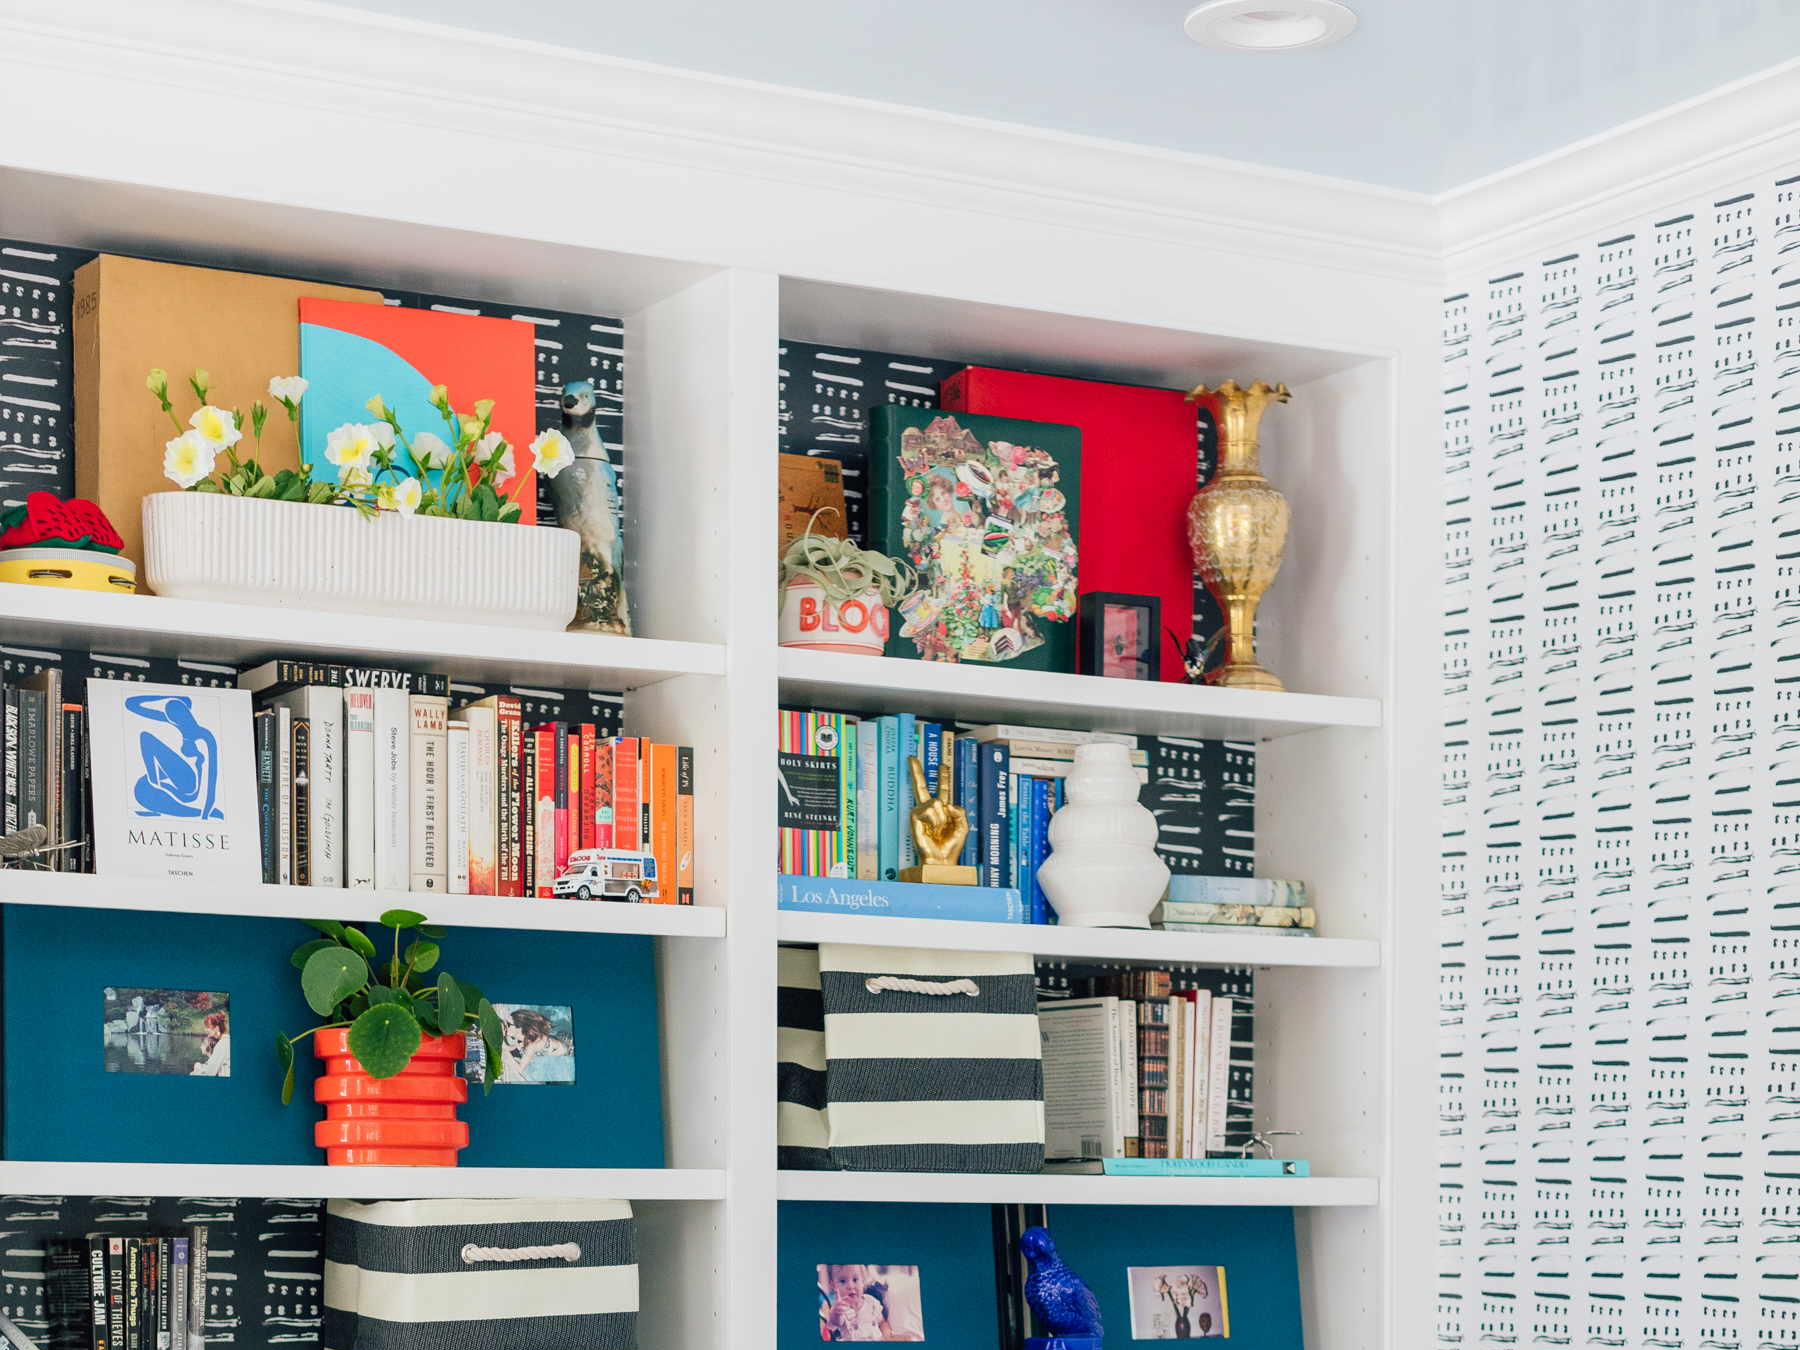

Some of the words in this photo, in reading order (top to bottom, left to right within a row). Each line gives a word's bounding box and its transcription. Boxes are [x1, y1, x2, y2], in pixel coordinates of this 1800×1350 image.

[75, 292, 97, 320] 1985
[344, 669, 411, 690] SWERVE
[350, 693, 372, 709] BELOVED
[415, 708, 445, 718] WALLY
[6, 705, 17, 727] BLACK
[417, 720, 443, 730] LAMB
[323, 721, 334, 749] DONNA
[500, 735, 508, 758] Osage
[511, 720, 519, 767] Killers
[390, 751, 398, 770] Jobs
[426, 742, 434, 757] THE
[527, 756, 532, 764] WE
[864, 742, 873, 760] The
[928, 741, 938, 765] HOUSE
[6, 751, 17, 776] WHITE
[324, 753, 332, 783] TARTT
[426, 762, 434, 785] HOUR
[511, 769, 519, 778] of
[780, 759, 801, 767] HOLY
[805, 761, 836, 769] SKIRTS
[28, 766, 36, 801] PAPERS
[390, 772, 398, 782] by
[864, 762, 874, 791] Island
[929, 782, 938, 794] THE
[282, 795, 288, 806] OF
[887, 766, 895, 812] BUDDHA
[1021, 782, 1029, 809] Setting
[426, 796, 434, 821] FIRST
[511, 792, 519, 840] Flower
[998, 791, 1006, 818] James
[128, 829, 230, 850] MATISSE
[426, 826, 434, 867] BELIEVED
[501, 843, 508, 853] of
[846, 825, 854, 872] VONNEGUT
[990, 823, 999, 865] MORNING
[791, 885, 822, 904] Los
[825, 887, 889, 910] Angeles
[92, 1250, 104, 1296] CULTURE
[129, 1247, 137, 1279] Among
[111, 1270, 122, 1290] CITY
[114, 1295, 122, 1304] OF
[94, 1300, 105, 1325] JAM
[129, 1298, 137, 1327] Thugs
[112, 1308, 123, 1346] THIEVES
